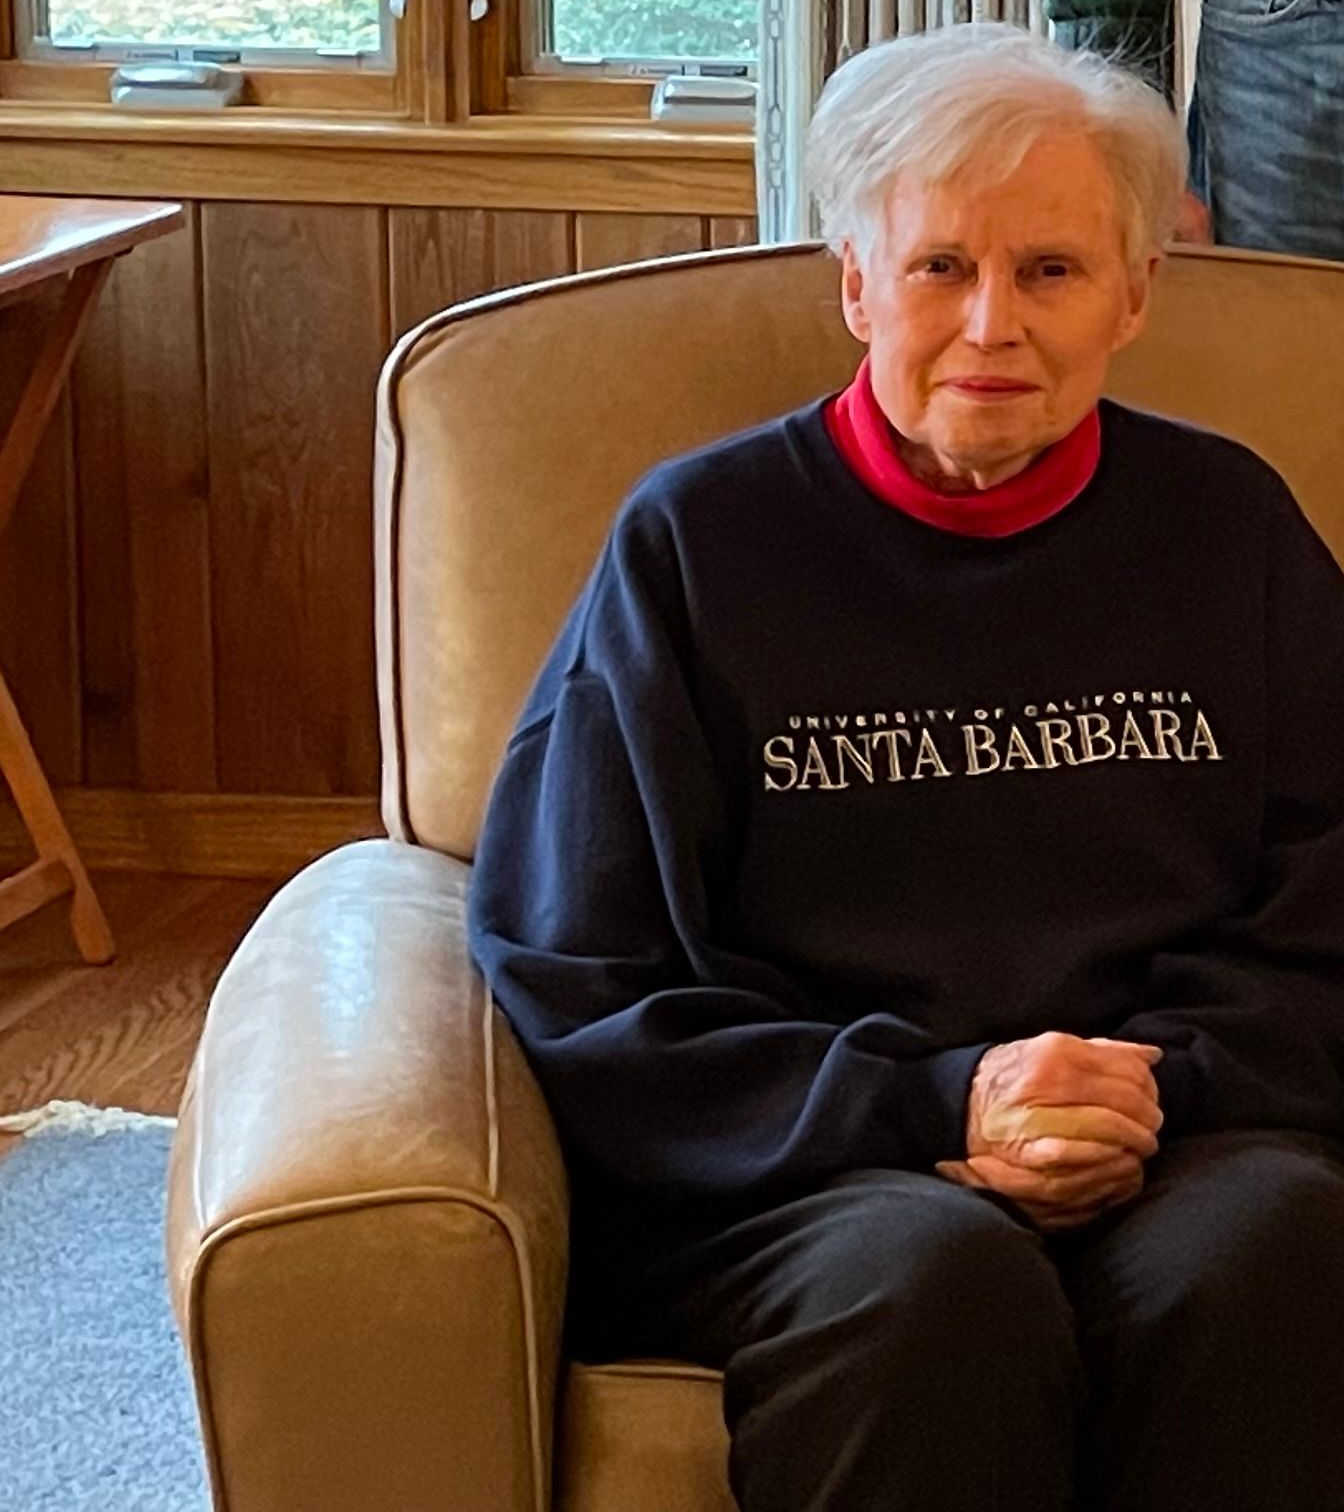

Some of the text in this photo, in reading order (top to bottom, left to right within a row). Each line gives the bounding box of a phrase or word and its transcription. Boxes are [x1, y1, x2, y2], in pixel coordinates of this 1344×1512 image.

[788, 691, 1193, 730] UNIVERSITY OF CALIFORNIA
[763, 708, 1223, 791] SANTA BARBARA
